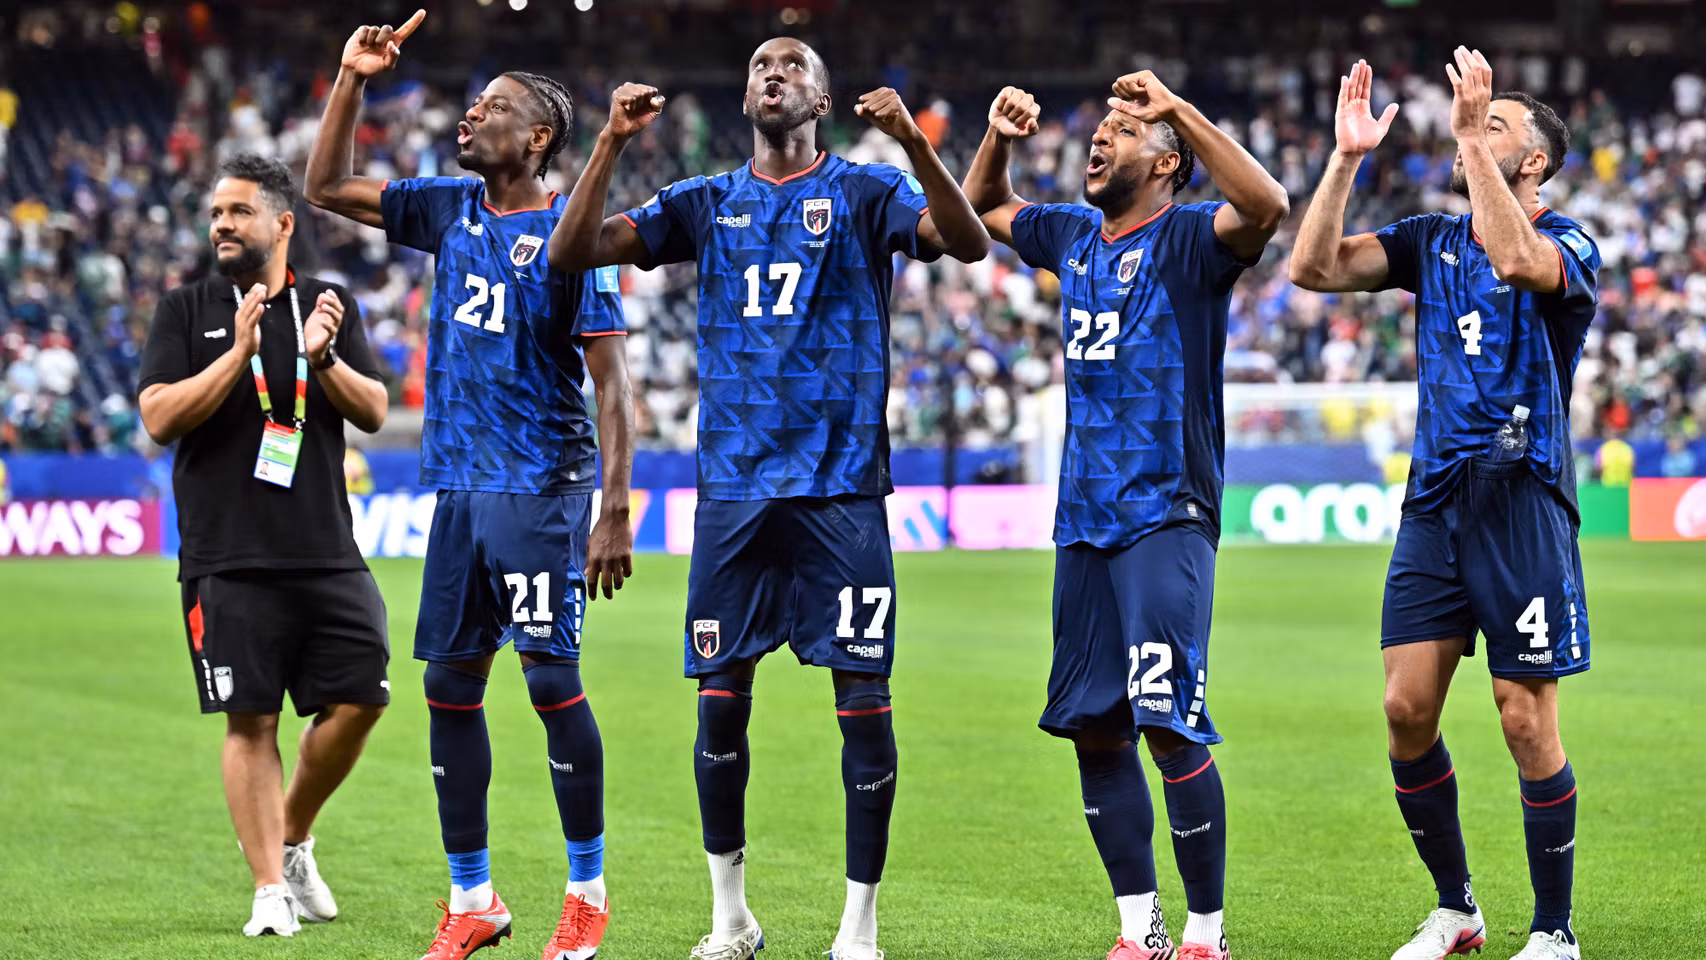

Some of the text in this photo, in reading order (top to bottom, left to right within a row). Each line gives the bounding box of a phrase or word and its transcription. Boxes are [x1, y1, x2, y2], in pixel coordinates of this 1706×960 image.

[716, 213, 751, 226] capelli
[454, 273, 506, 333] 21
[743, 262, 802, 316] 17
[1066, 308, 1120, 360] 22
[1457, 310, 1482, 355] 4
[0, 499, 144, 556] WAYS
[504, 572, 553, 622] 21
[836, 586, 892, 639] 17
[1515, 597, 1549, 648] 4
[847, 644, 884, 656] capelli
[1127, 642, 1173, 700] 22
[1518, 650, 1553, 663] capelli
[1138, 698, 1172, 711] capelli
